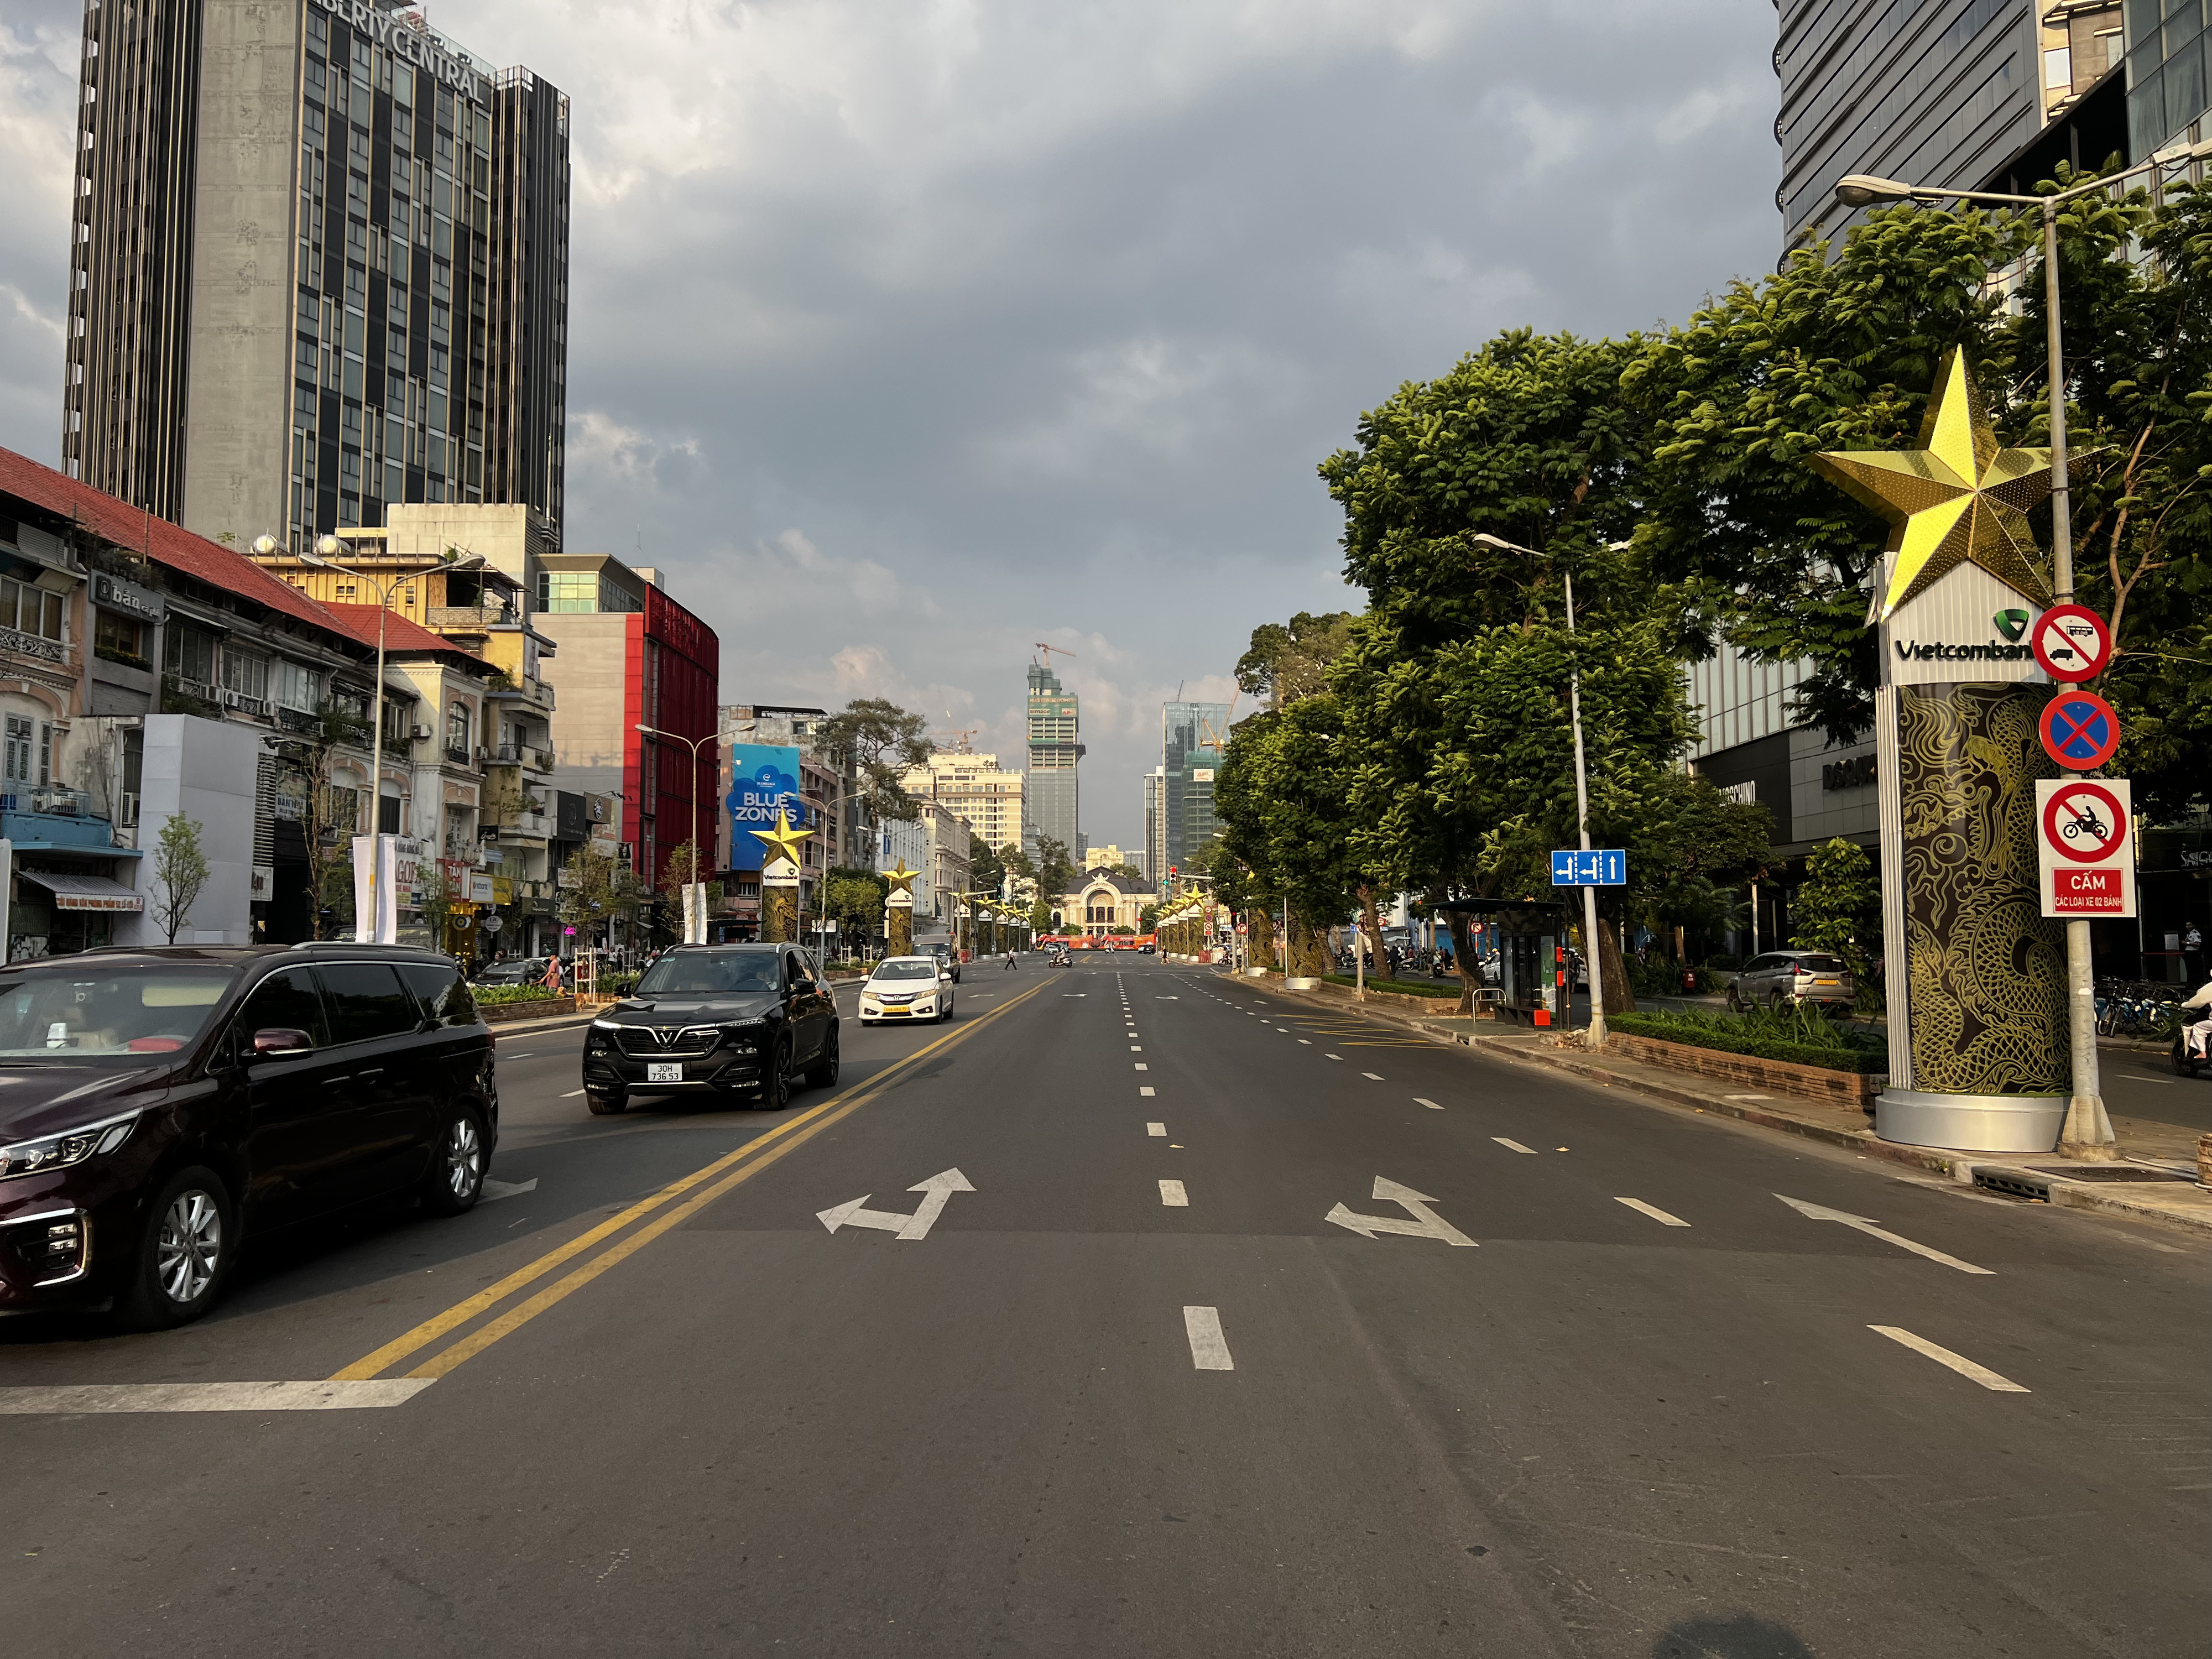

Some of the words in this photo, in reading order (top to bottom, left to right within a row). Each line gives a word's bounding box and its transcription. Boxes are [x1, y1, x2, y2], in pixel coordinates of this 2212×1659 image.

[312, 0, 390, 44] BERTY
[392, 28, 483, 104] CENTRAL
[744, 792, 789, 807] BLUE
[2071, 870, 2106, 890] CẤM
[2055, 894, 2068, 906] CÁC
[2069, 896, 2084, 909] LOẠI
[2085, 896, 2094, 906] XE
[2095, 896, 2103, 906] 02
[2104, 894, 2122, 906] BÁNH
